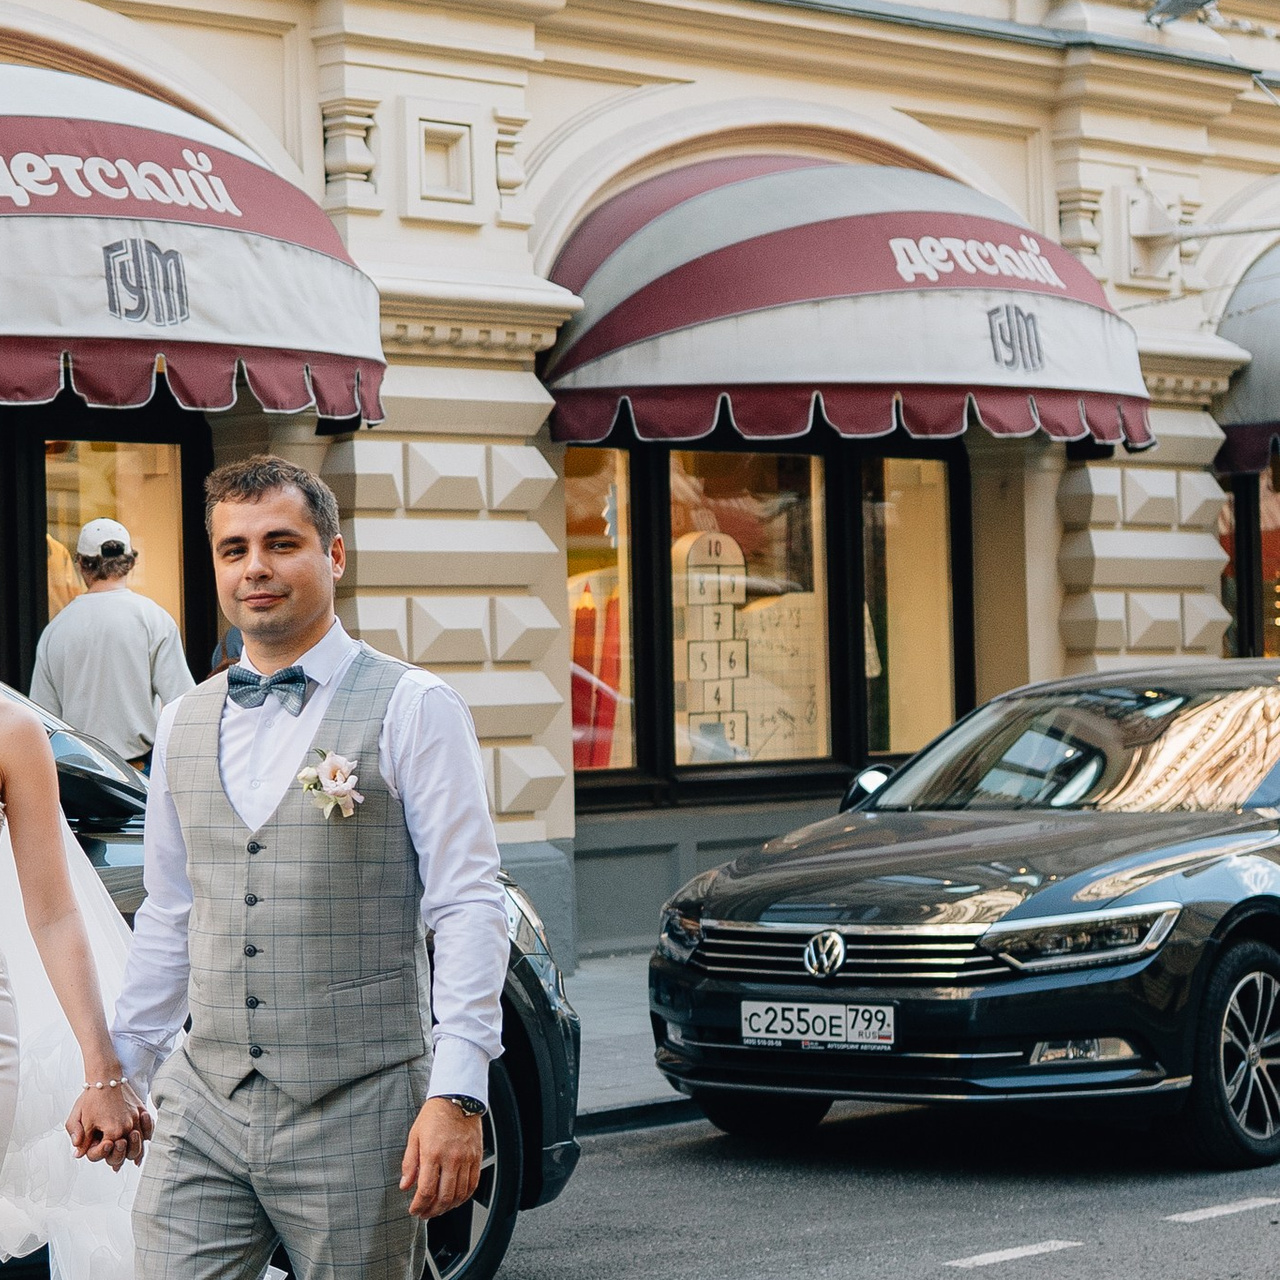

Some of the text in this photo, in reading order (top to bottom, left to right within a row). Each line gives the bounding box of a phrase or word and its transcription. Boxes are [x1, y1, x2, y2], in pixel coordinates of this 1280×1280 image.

[102, 237, 190, 327] ГУМ
[986, 303, 1046, 373] ГУМ
[708, 539, 722, 558] 10
[713, 612, 722, 631] 7
[700, 650, 736, 672] 5 6
[714, 686, 722, 706] 4
[729, 719, 736, 741] 3
[748, 1006, 887, 1037] С255ОЕ 799
[858, 1030, 878, 1040] RUS
